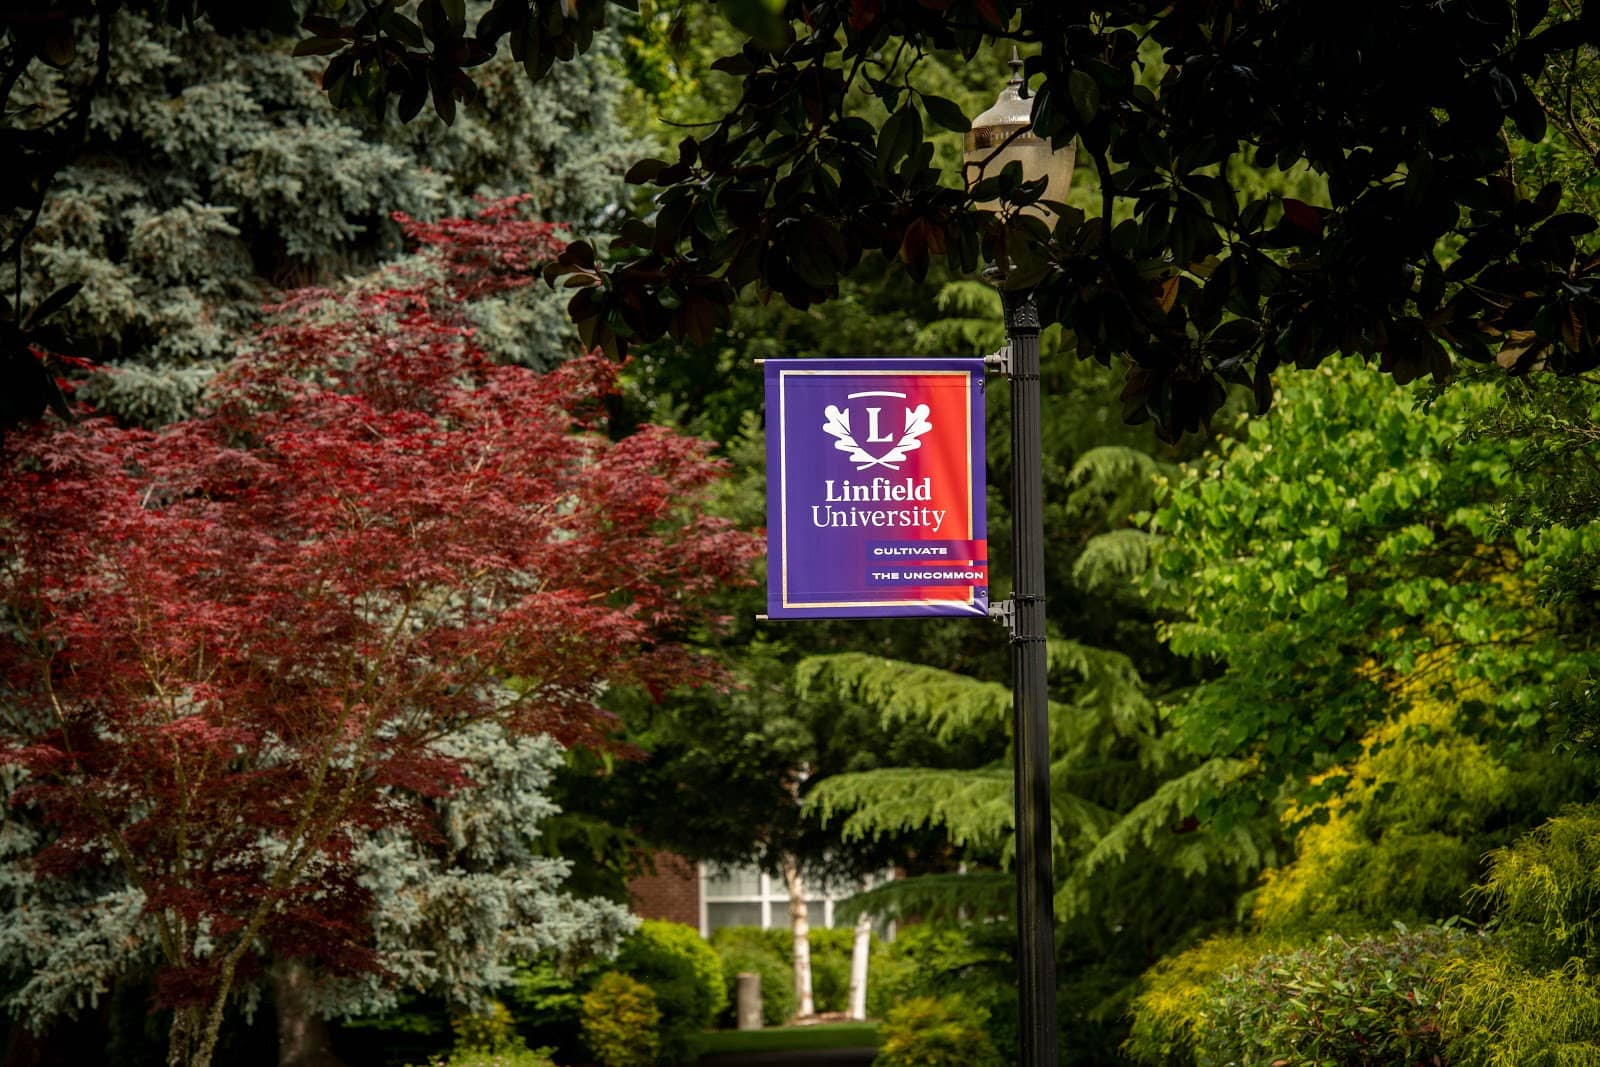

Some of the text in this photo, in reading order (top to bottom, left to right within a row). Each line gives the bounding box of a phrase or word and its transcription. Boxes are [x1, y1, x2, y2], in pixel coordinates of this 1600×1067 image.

[866, 407, 894, 442] L
[825, 477, 931, 502] Linfield
[811, 505, 946, 532] University
[873, 547, 948, 555] CULTIVATE
[872, 571, 984, 580] THE UNCOMMON
